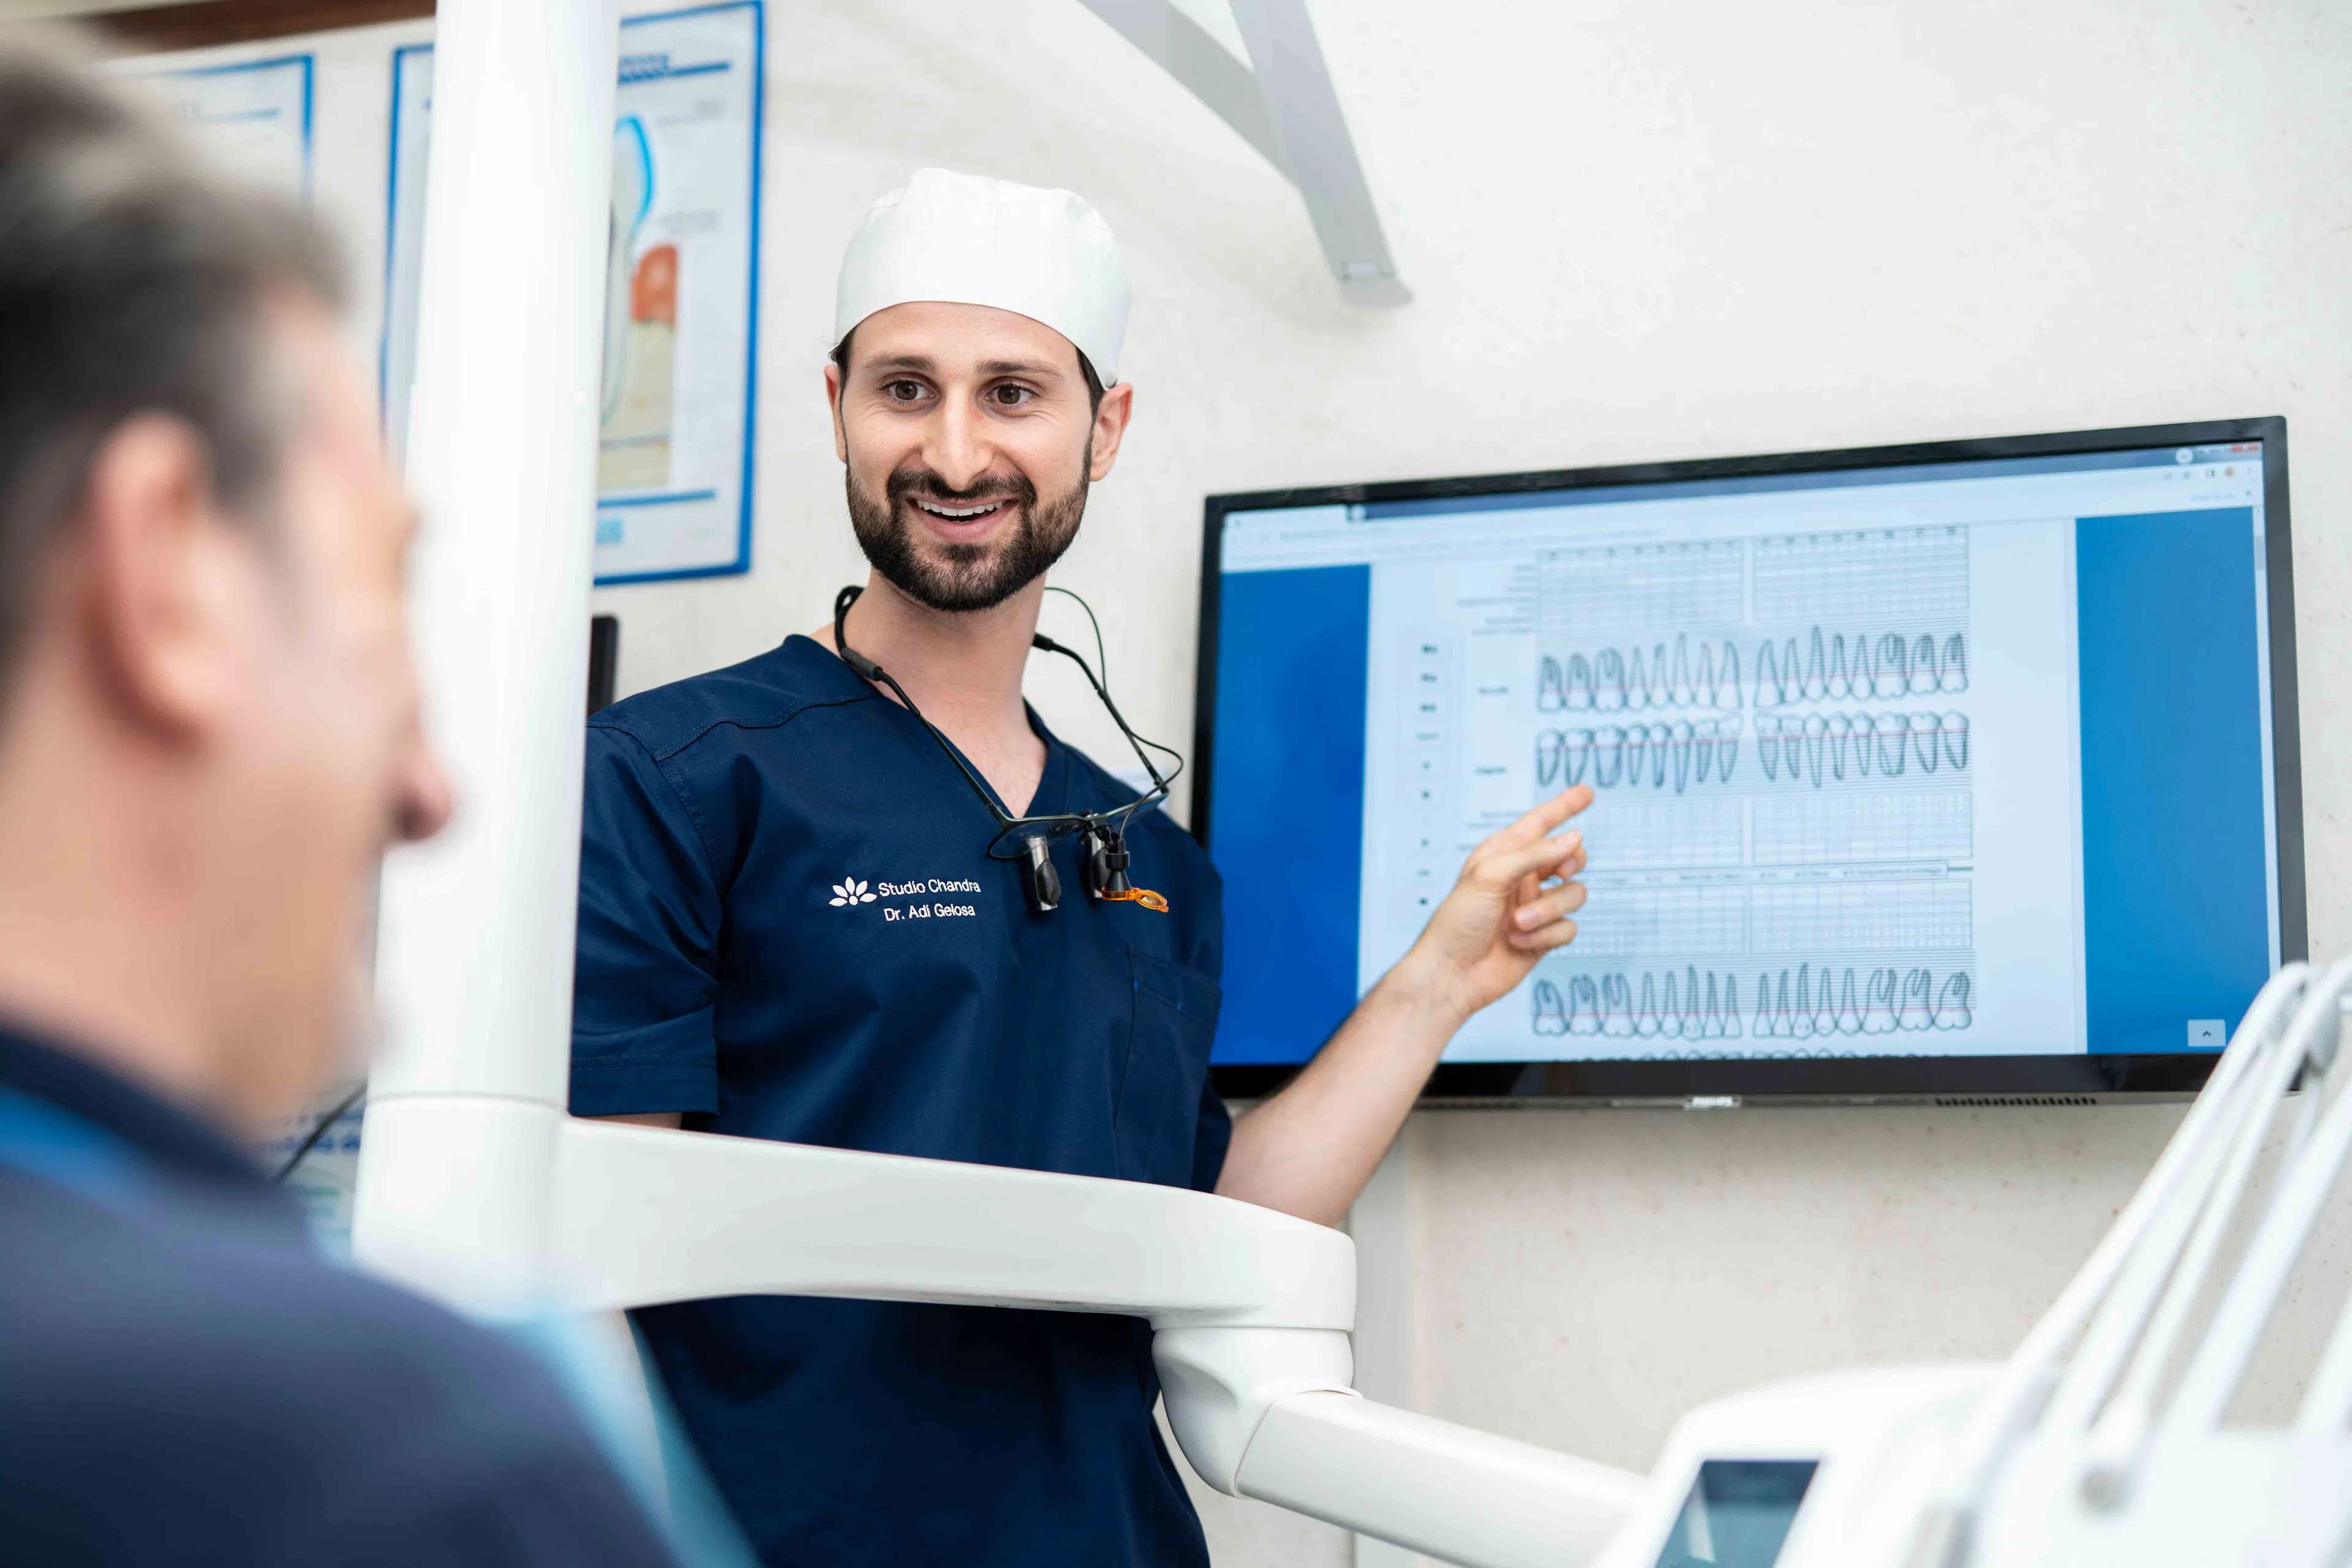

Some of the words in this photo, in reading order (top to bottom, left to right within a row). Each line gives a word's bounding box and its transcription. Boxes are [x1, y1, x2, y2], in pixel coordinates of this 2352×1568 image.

[878, 881, 926, 897] Studio
[928, 878, 981, 893] Chandra
[884, 908, 905, 921] Dr.
[909, 904, 930, 918] Adi
[934, 903, 975, 918] Gelosa
